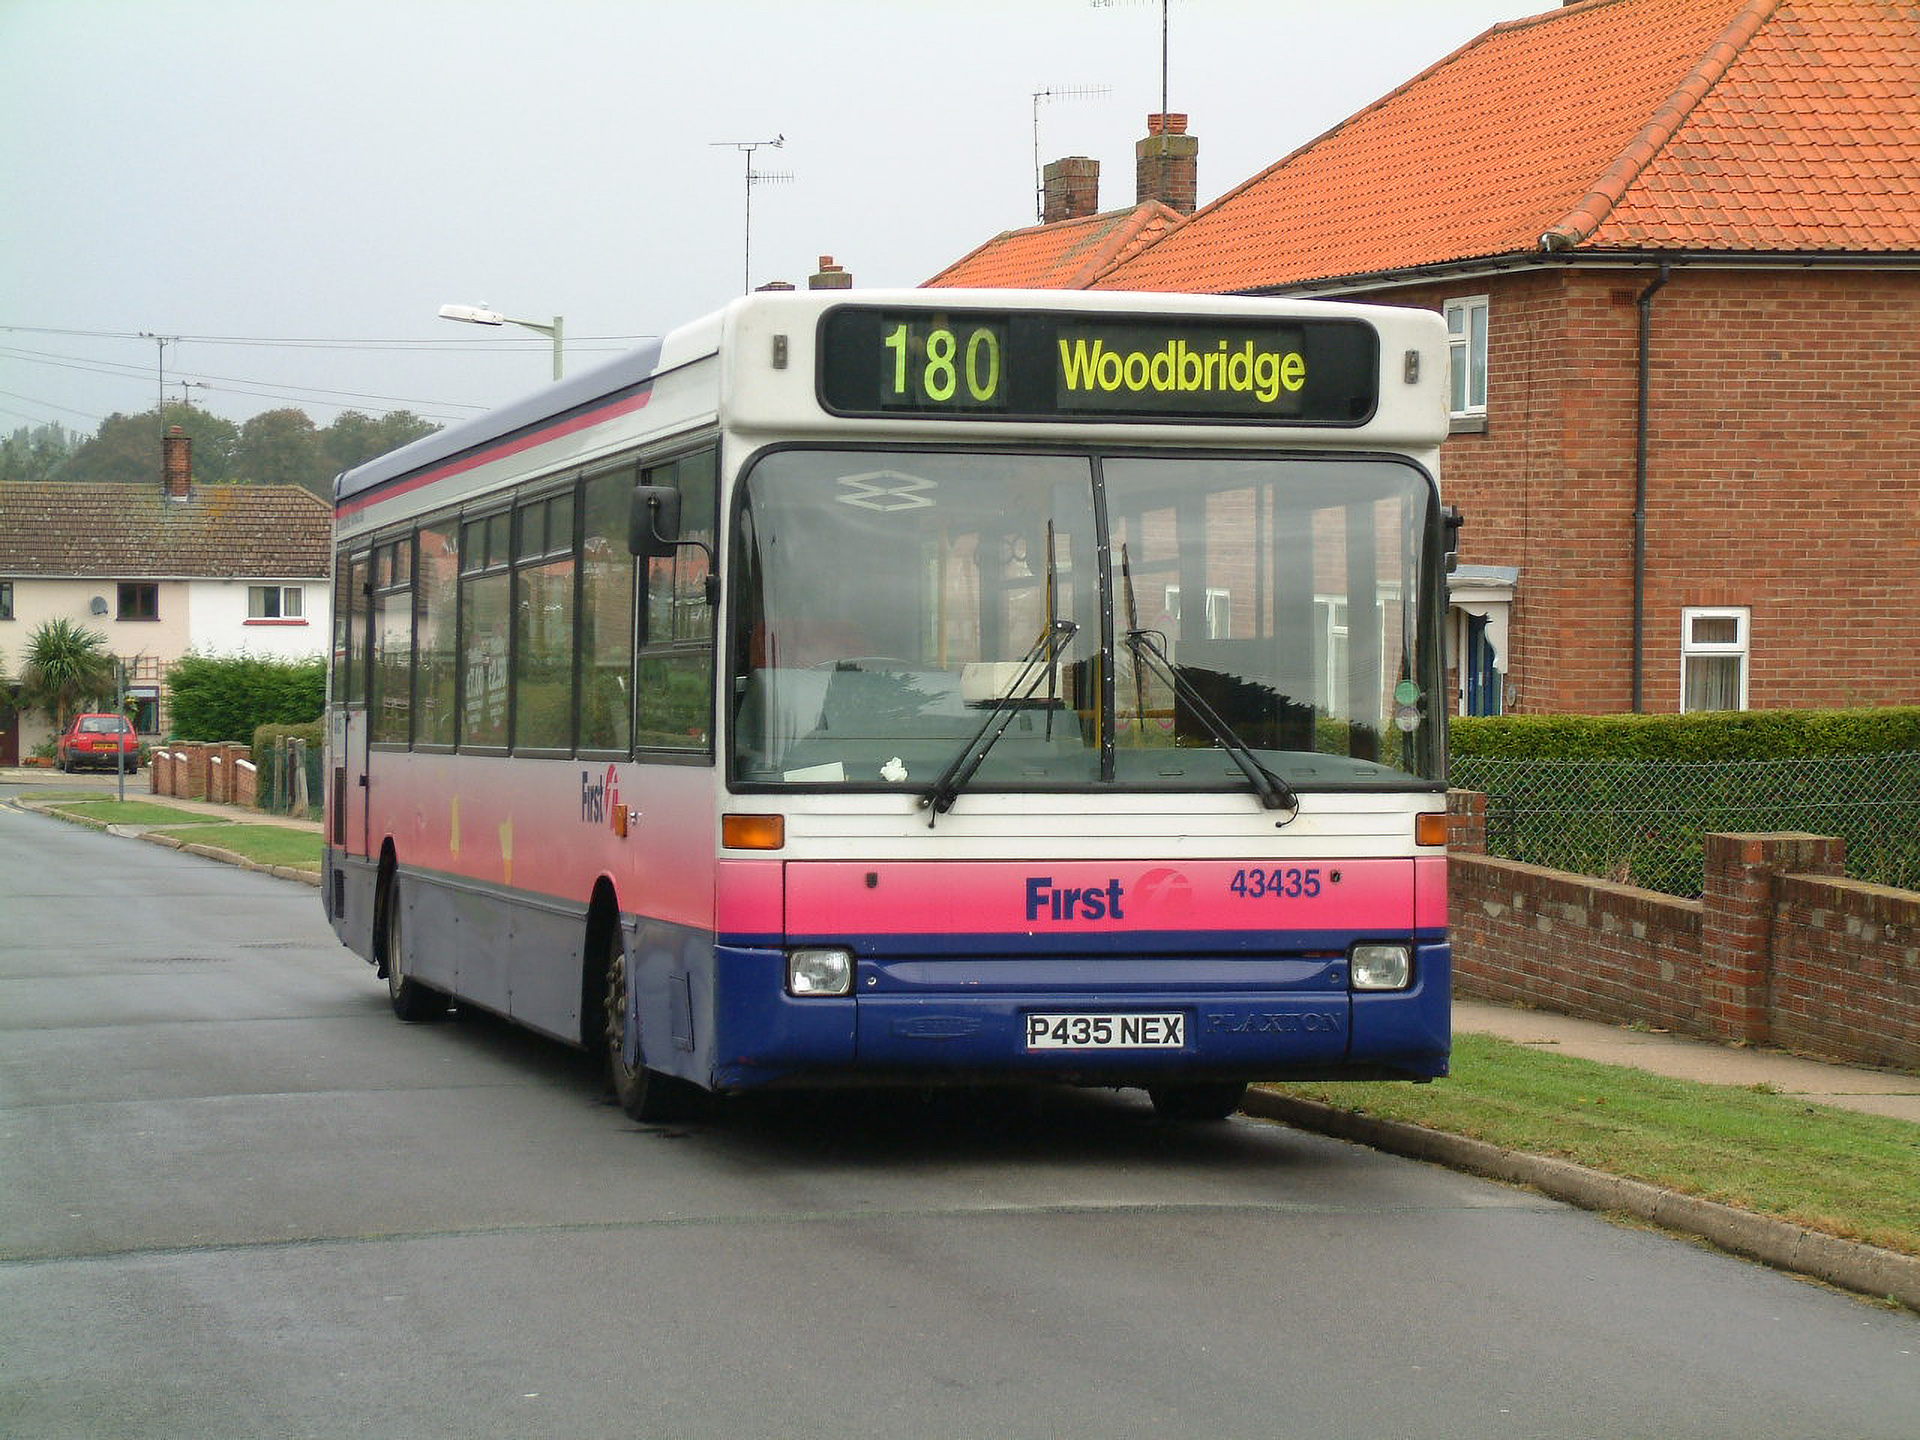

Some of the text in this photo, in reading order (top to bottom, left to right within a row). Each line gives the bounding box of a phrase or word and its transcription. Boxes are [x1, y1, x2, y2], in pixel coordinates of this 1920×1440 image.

[885, 324, 1306, 402] 180 Woodbridge
[582, 771, 603, 823] First
[1026, 876, 1125, 921] First
[1231, 868, 1321, 898] 43435
[1029, 1017, 1182, 1045] P435 NEX
[1206, 1012, 1342, 1033] PLAXTON
